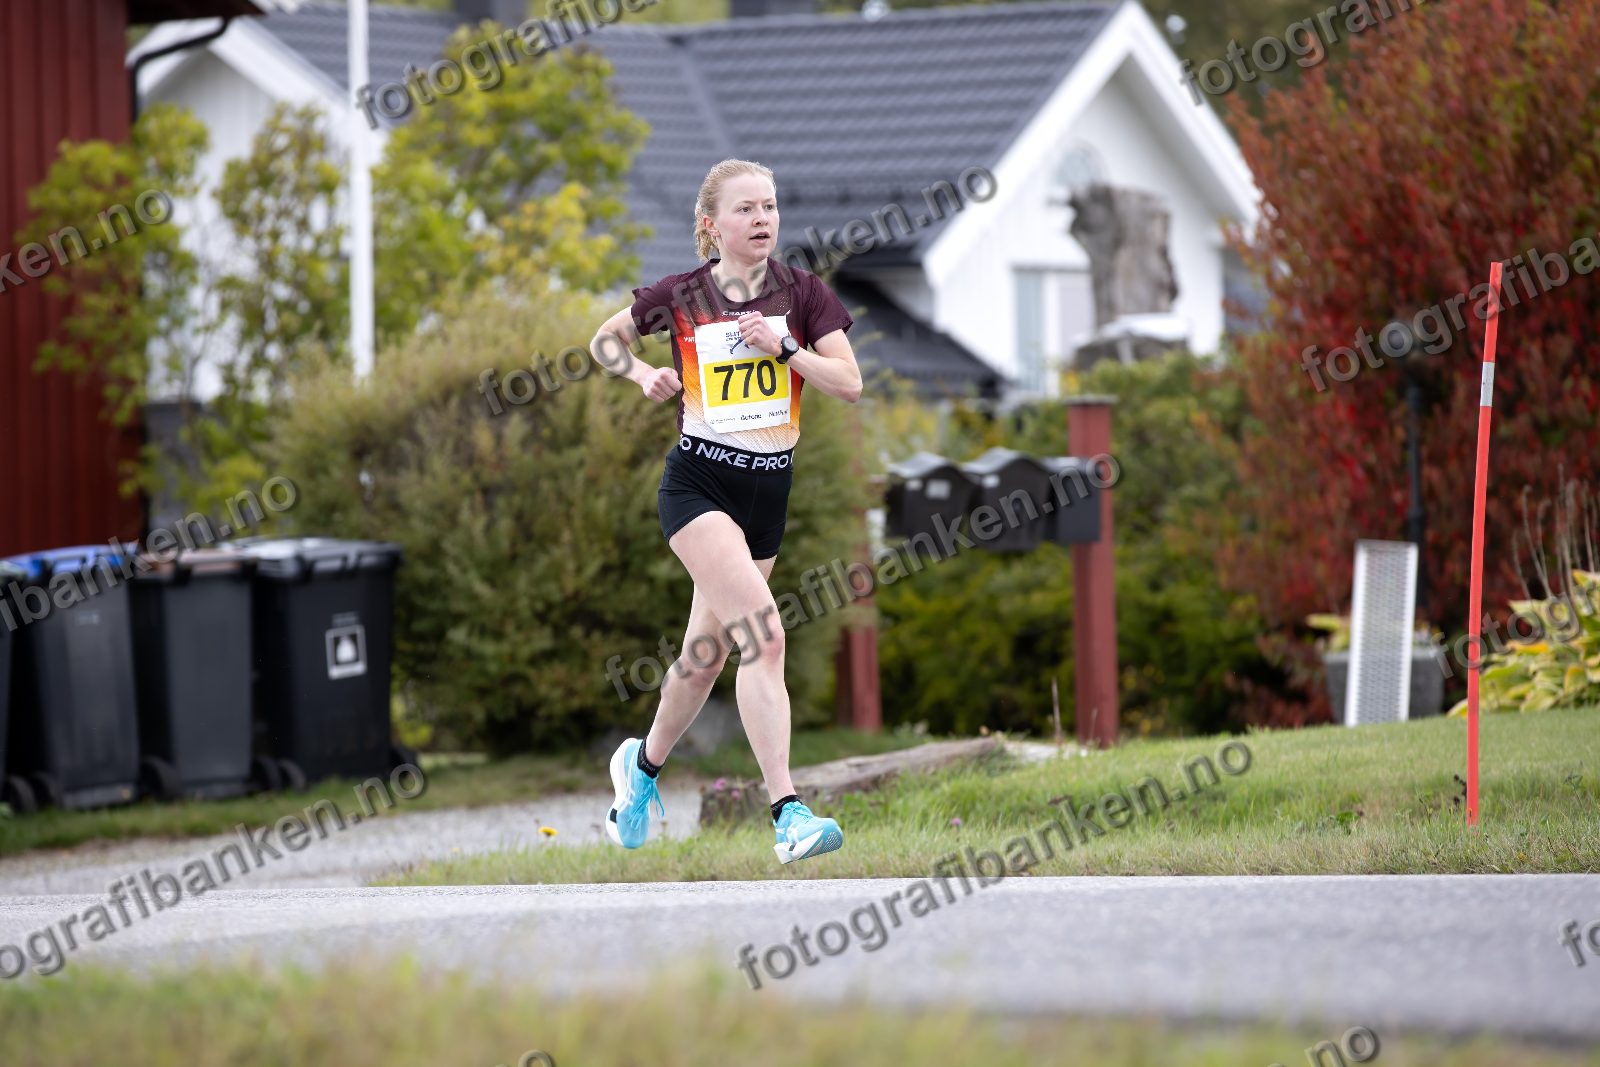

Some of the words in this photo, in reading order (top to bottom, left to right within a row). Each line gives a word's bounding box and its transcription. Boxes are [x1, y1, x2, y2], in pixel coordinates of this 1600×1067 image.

[713, 359, 777, 401] 770
[695, 442, 751, 468] NIKE
[751, 454, 789, 471] PRO
